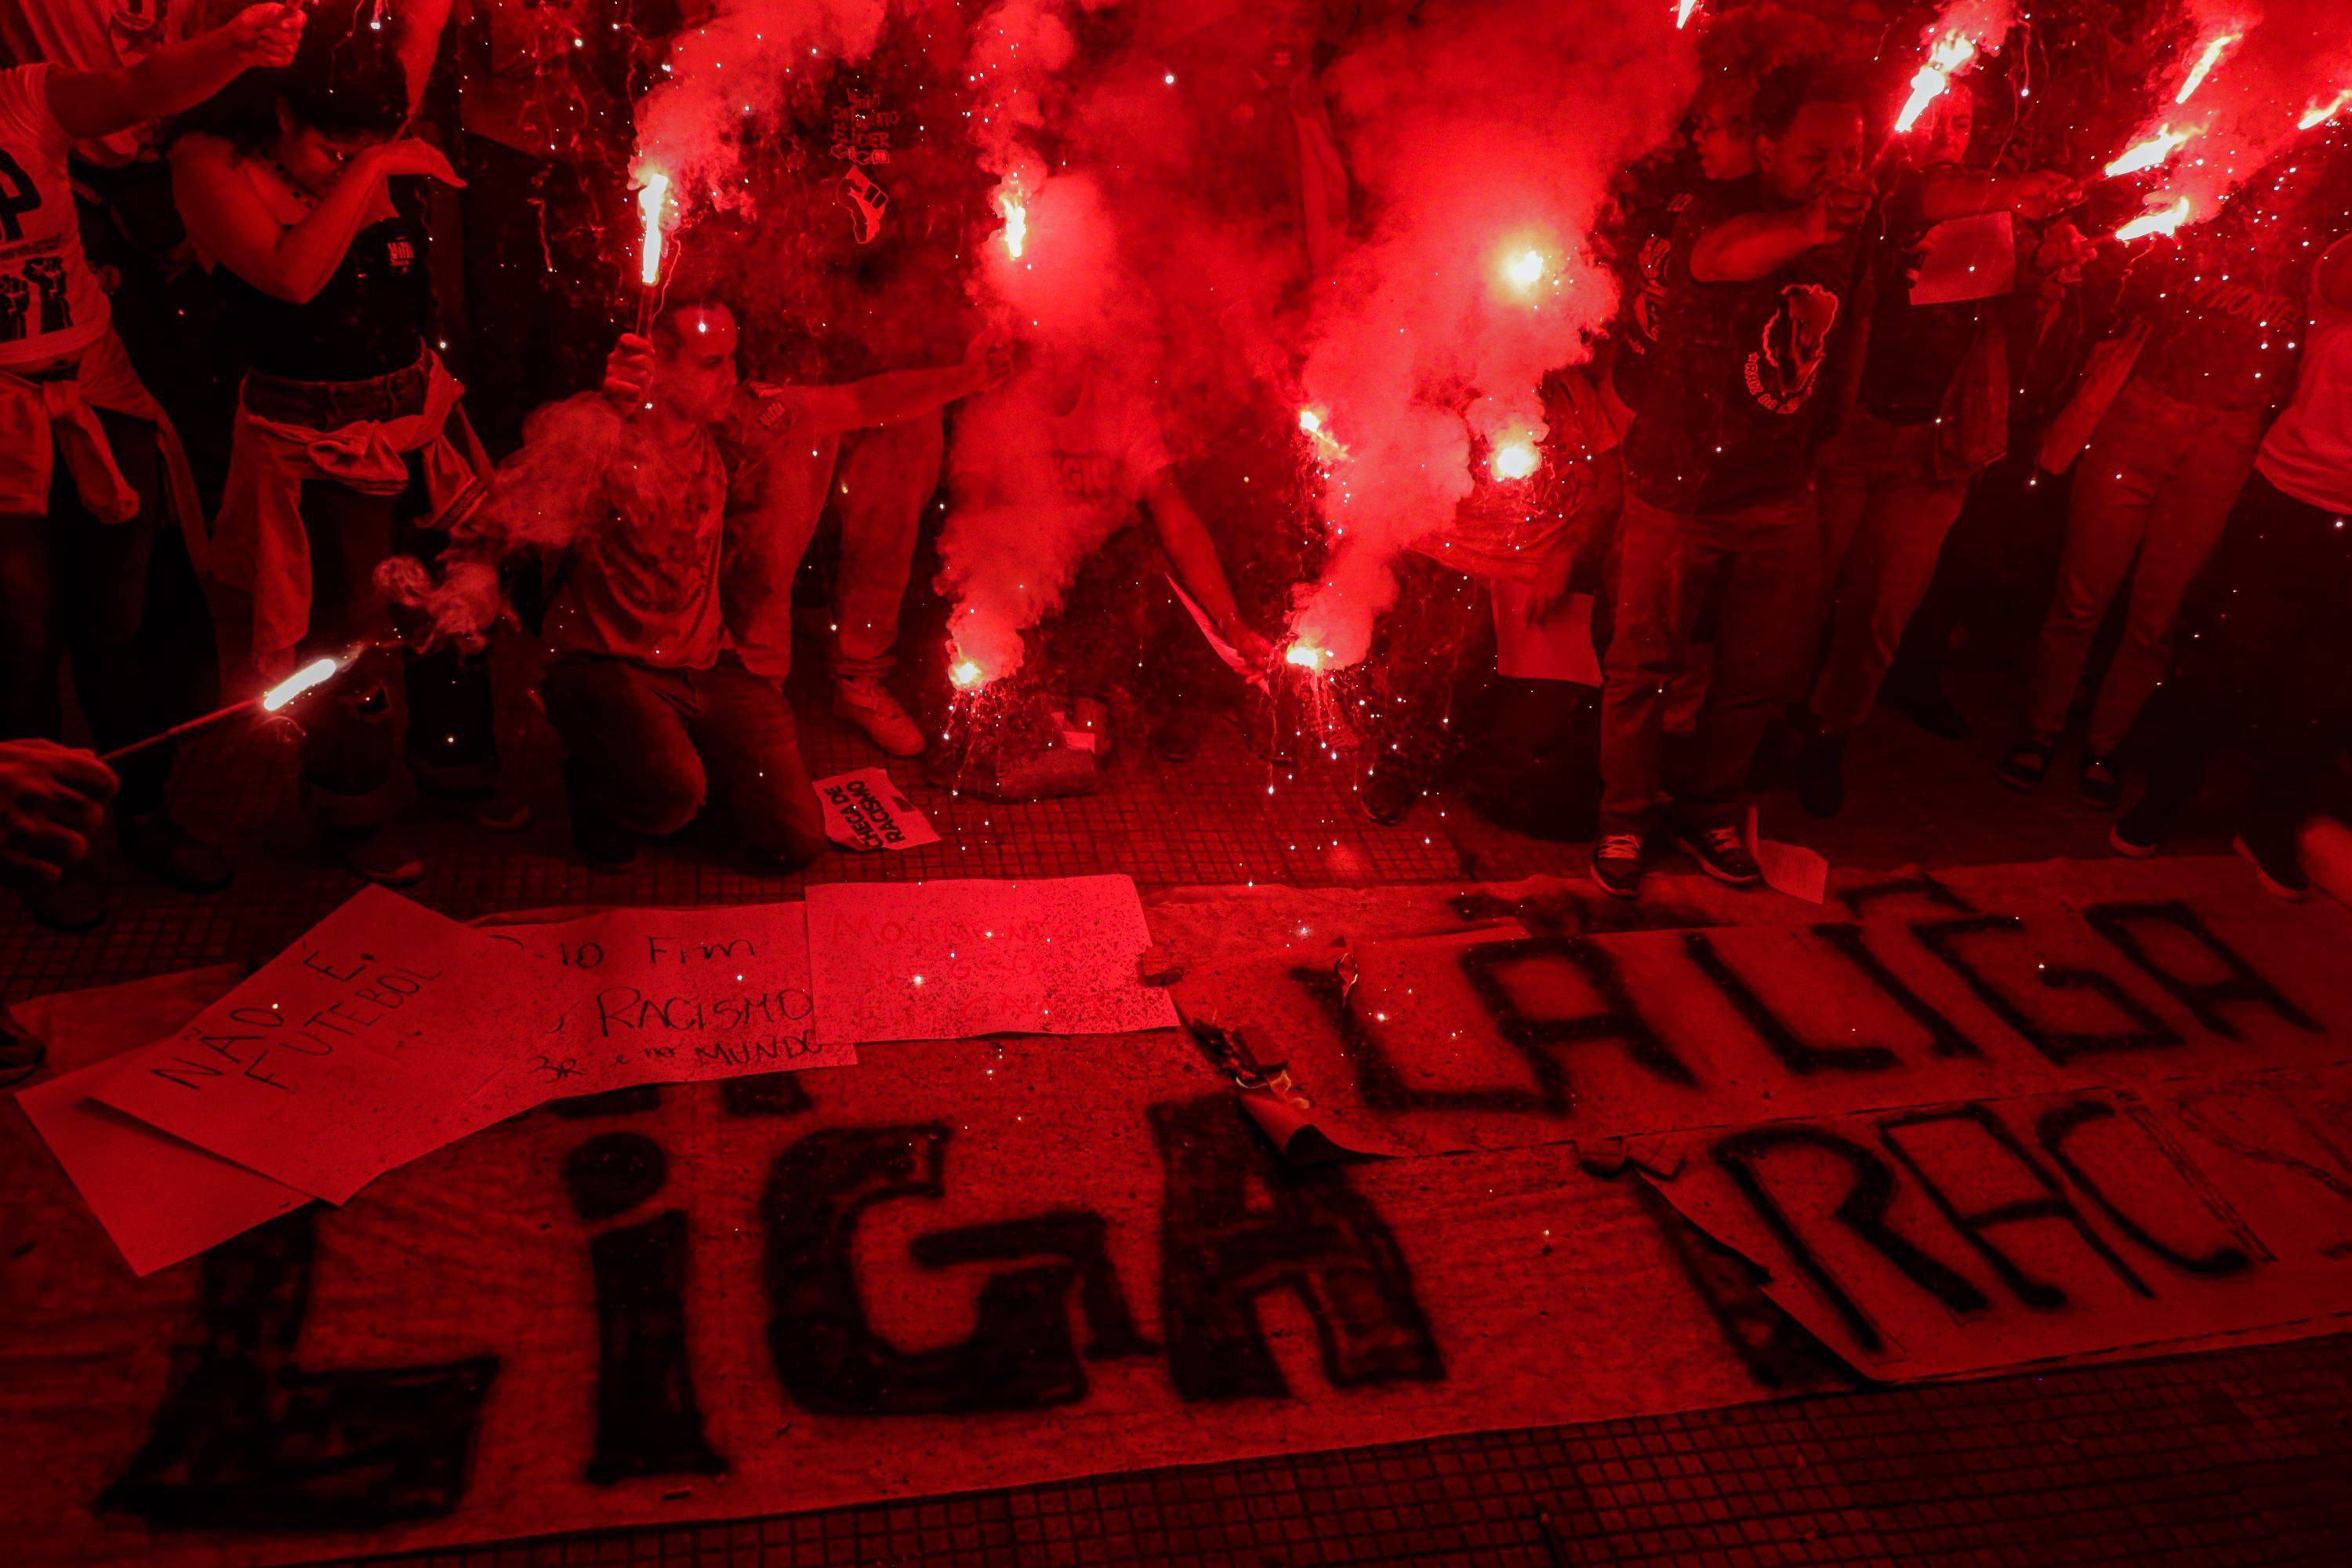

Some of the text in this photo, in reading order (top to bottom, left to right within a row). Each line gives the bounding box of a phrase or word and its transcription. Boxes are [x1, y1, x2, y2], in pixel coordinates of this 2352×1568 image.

[825, 785, 883, 848] CHEGA DE
[847, 780, 906, 843] RACISMO
[243, 965, 444, 1094] FUTEBOL
[596, 985, 813, 1037] RACISMO
